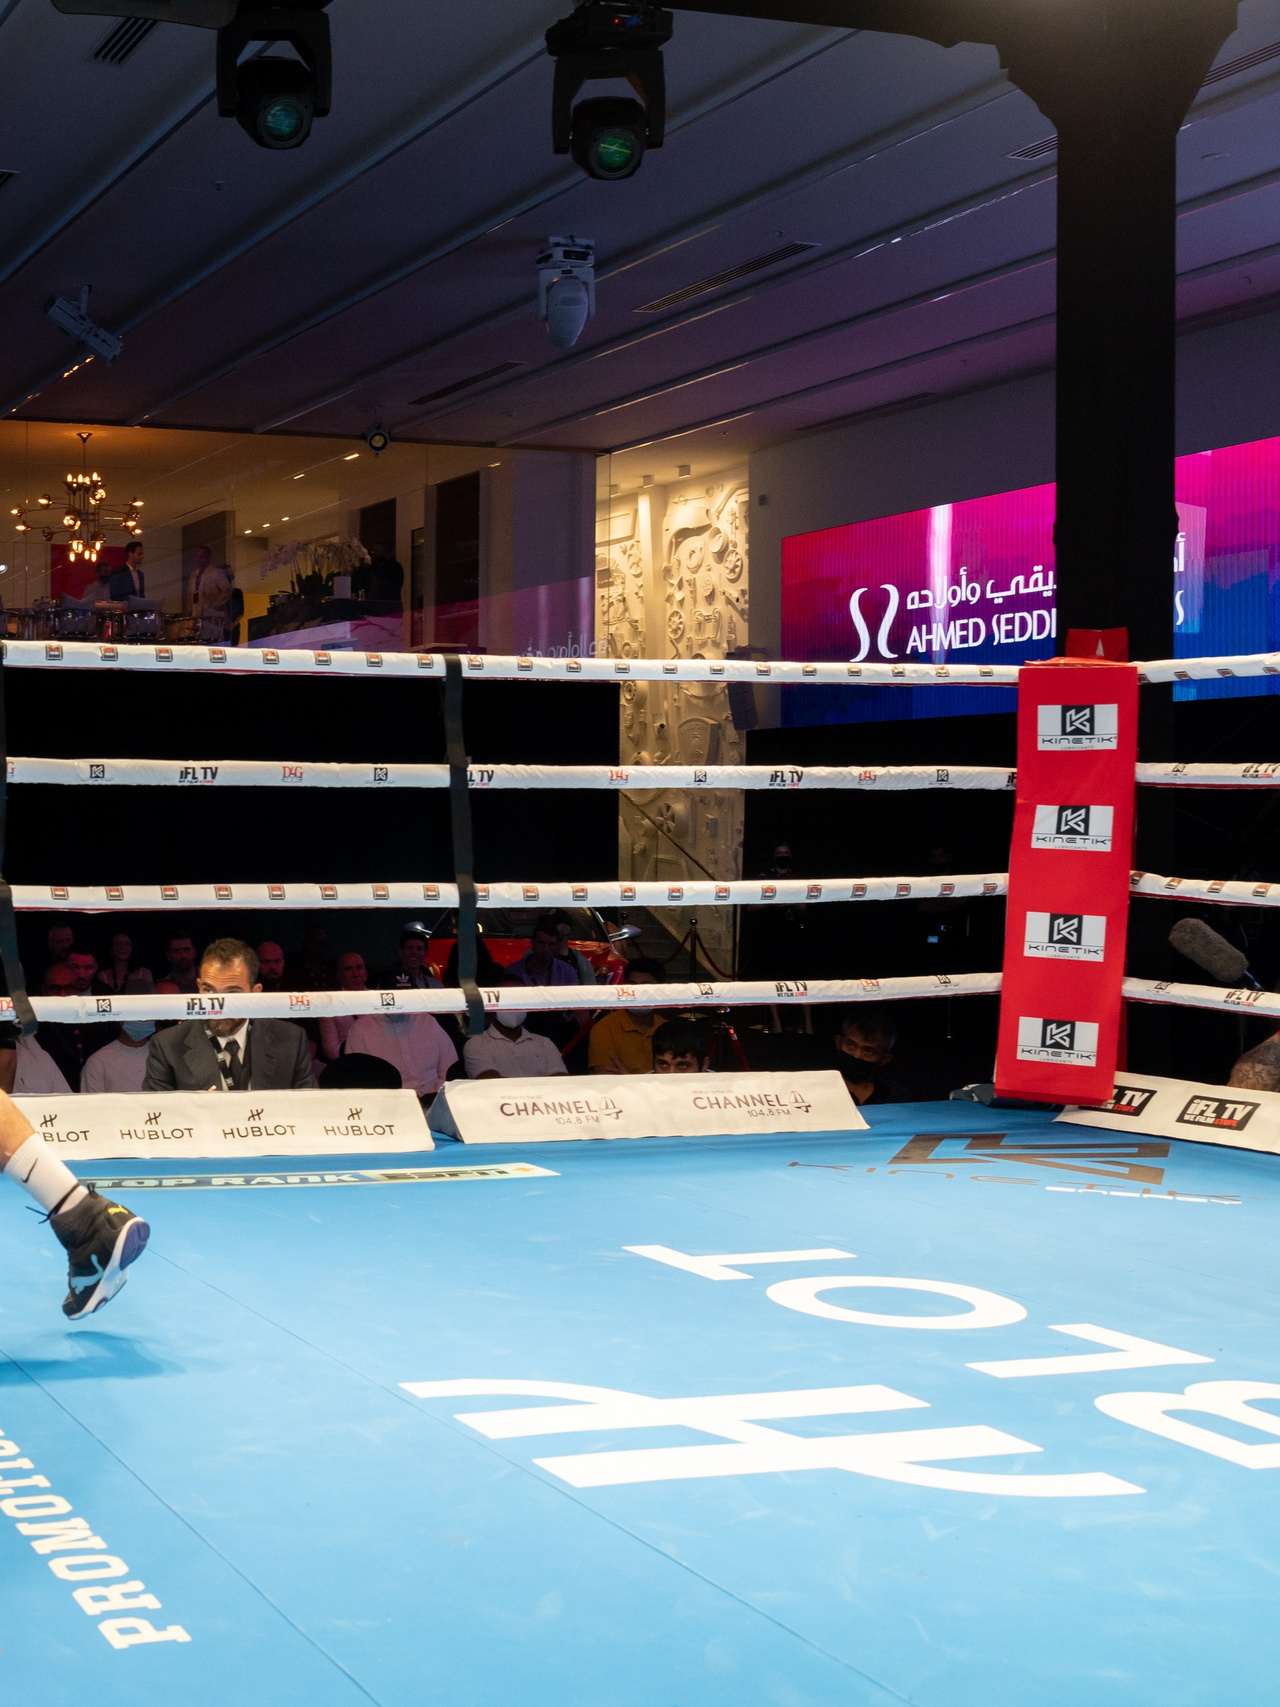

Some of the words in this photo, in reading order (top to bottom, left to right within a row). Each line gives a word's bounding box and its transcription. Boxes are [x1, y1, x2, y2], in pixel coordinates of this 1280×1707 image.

[906, 617, 986, 654] AHMED
[991, 608, 1058, 646] SEDDI
[1041, 736, 1115, 745] KINETIK
[200, 766, 218, 780] TV
[478, 769, 494, 782] TV
[1036, 836, 1109, 845] KINETIK
[1028, 944, 1100, 956] KINETIK
[484, 990, 500, 1003] TV
[0, 999, 14, 1012] D4
[186, 997, 206, 1011] iFL
[207, 997, 225, 1010] TV
[1021, 1048, 1093, 1060] KINETIK
[692, 1094, 788, 1110] CHANNEL
[1120, 1090, 1150, 1107] TV
[499, 1099, 598, 1117] CHANNEL
[747, 1109, 775, 1118] 104.8
[777, 1108, 792, 1116] FM
[1186, 1098, 1219, 1118] iFL
[1221, 1103, 1254, 1121] TV
[555, 1116, 583, 1126] 104.8
[586, 1115, 601, 1124] FM
[42, 1130, 90, 1142] BLOT
[120, 1128, 194, 1141] HUBLOT
[222, 1124, 296, 1139] HUBLOT
[323, 1124, 395, 1136] HUBLOT
[90, 1178, 197, 1187] TOP
[211, 1174, 360, 1186] RANK
